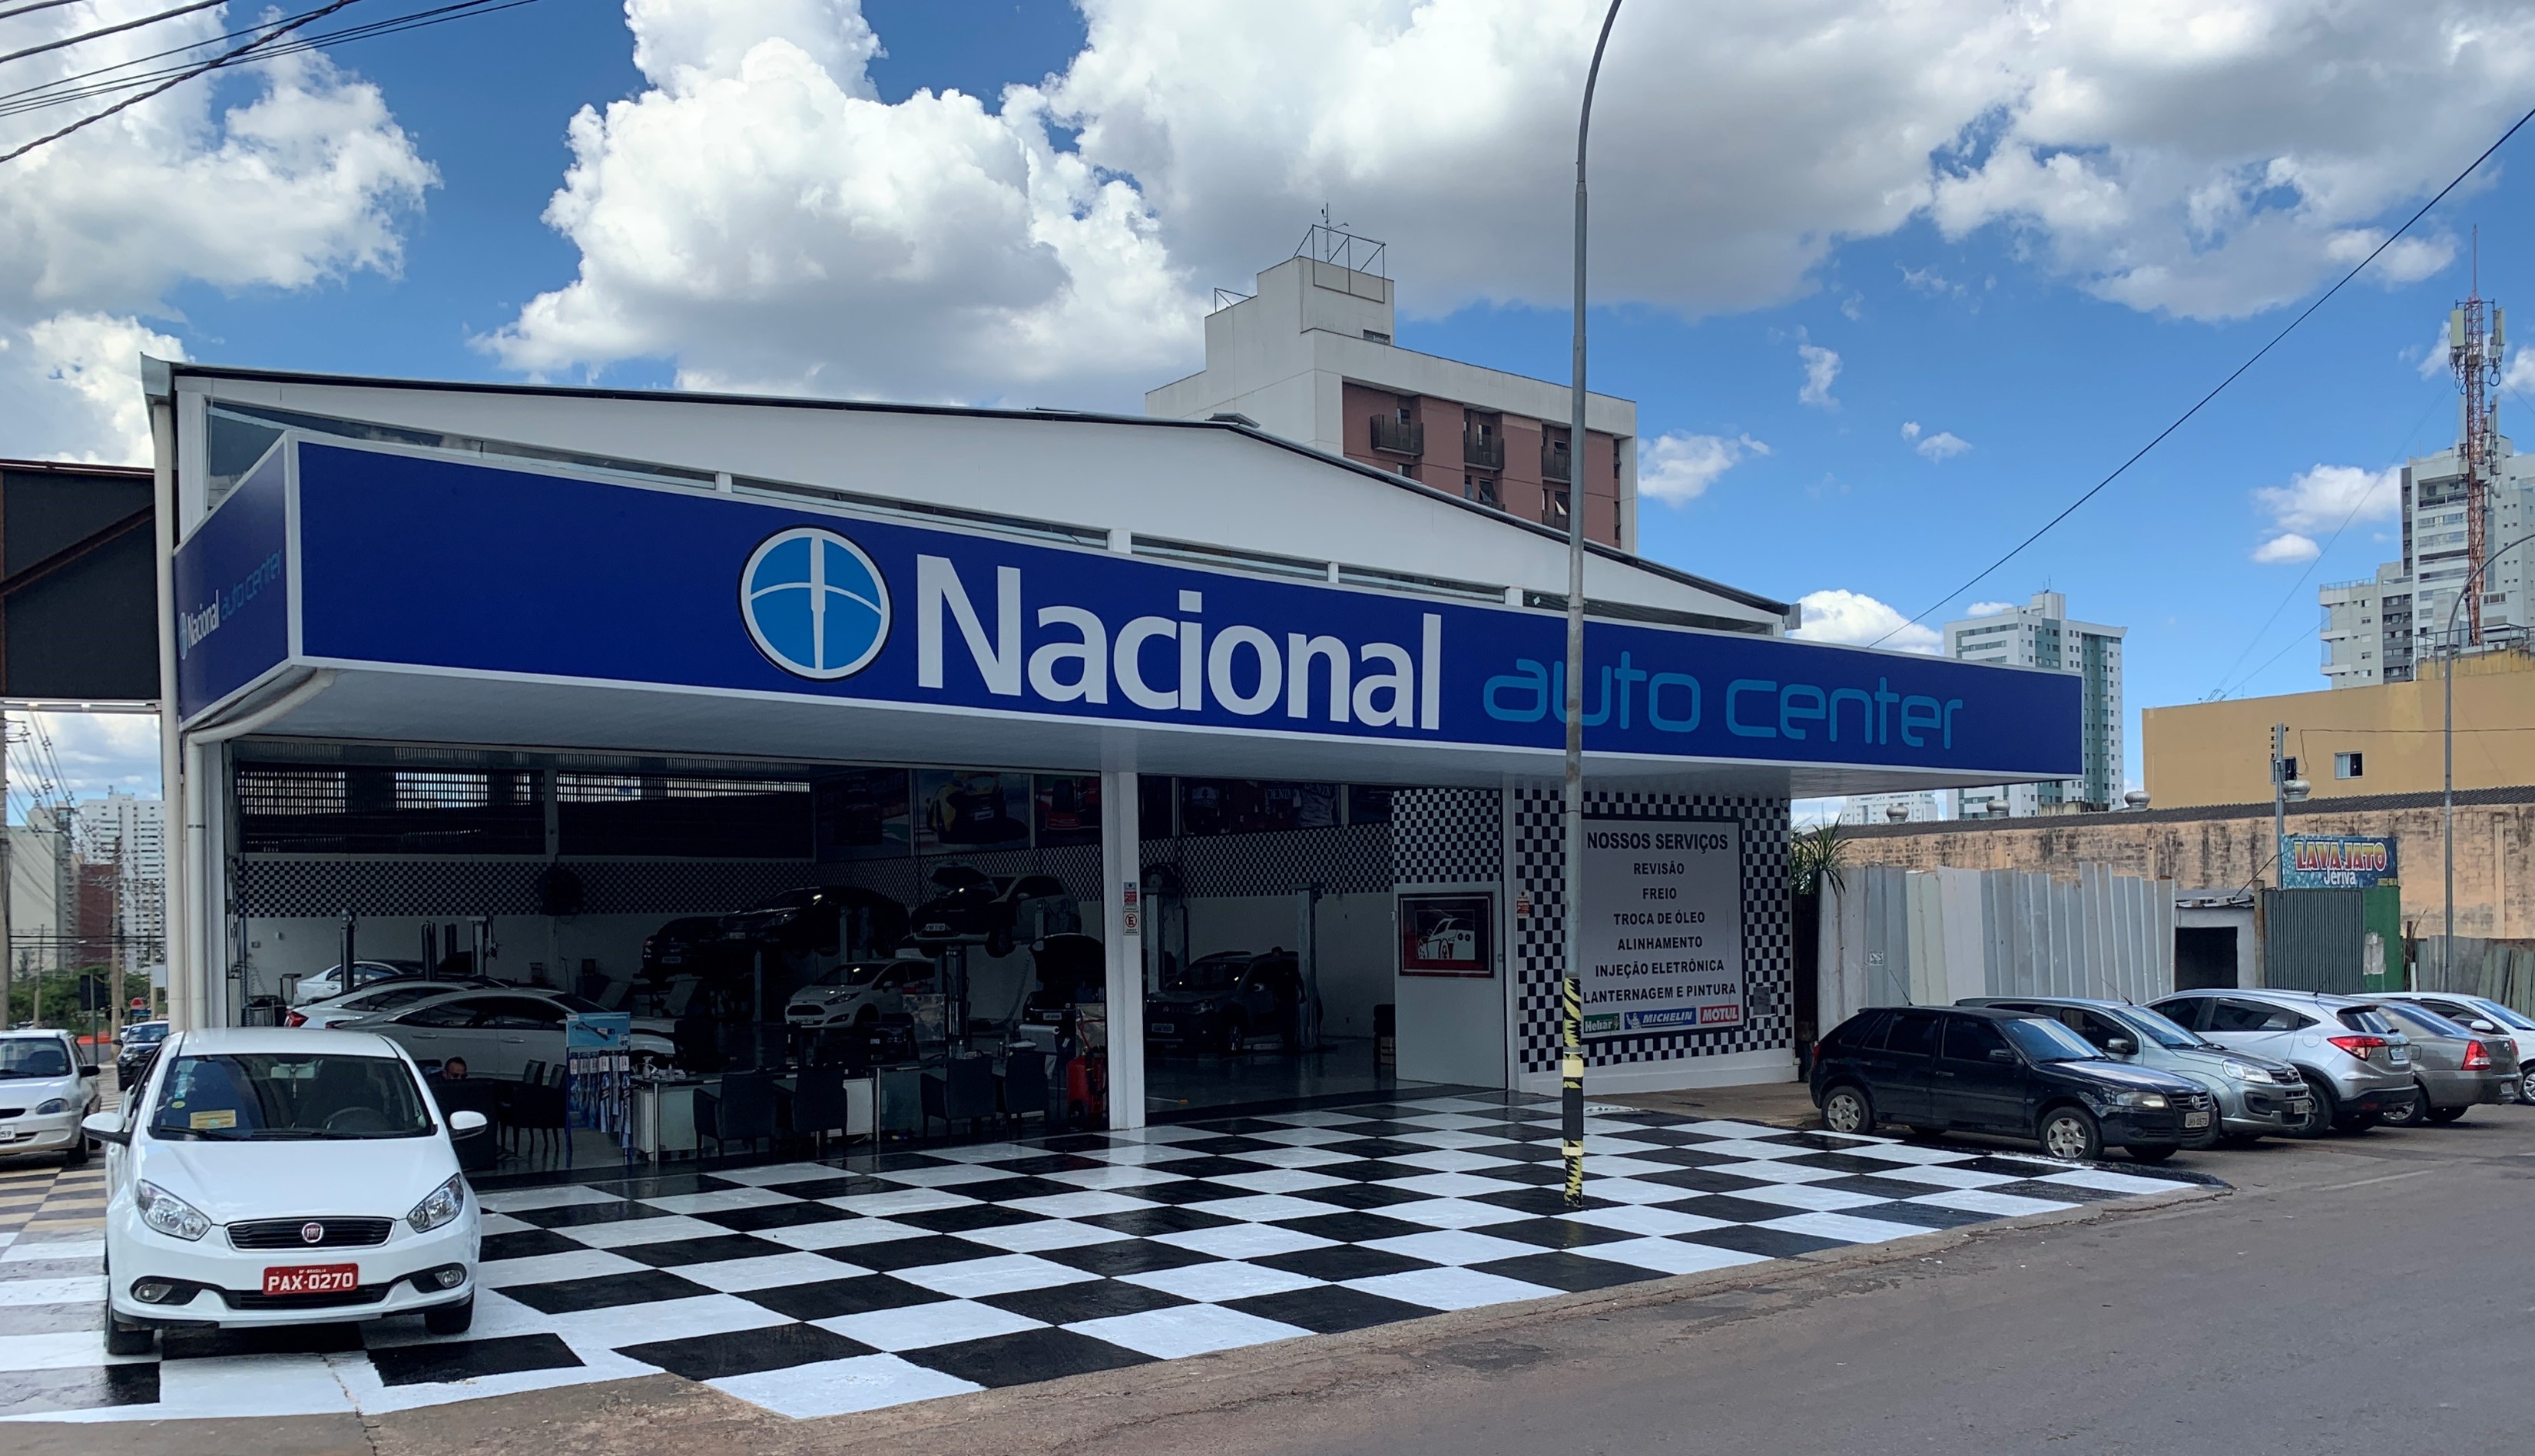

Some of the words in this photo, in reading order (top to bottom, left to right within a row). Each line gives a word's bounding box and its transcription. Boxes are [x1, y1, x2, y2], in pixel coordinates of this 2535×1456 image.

[187, 588, 220, 650] Nacional
[220, 583, 244, 621] auto
[245, 549, 283, 601] center
[918, 554, 1441, 730] Nacional
[1483, 650, 1701, 733] auto
[1725, 677, 1963, 750] center
[1587, 832, 1651, 849] NOSSOS
[1655, 833, 1728, 854] SERVIÇOS
[2293, 841, 2341, 871] LAVA
[2343, 841, 2388, 872] JATO
[1633, 860, 1685, 875] REVISÃO
[1642, 888, 1677, 899] FREIO
[1613, 913, 1654, 925] TROCA
[1657, 912, 1672, 925] DE
[1675, 909, 1705, 923] ÓLEO
[1617, 935, 1703, 951] ALINHAMENTO
[1596, 961, 1649, 979] INJEÇÃO
[1652, 958, 1725, 975] ELETRÔNICA
[1583, 986, 1673, 1004] LANTERNAGEM
[1677, 986, 1683, 998] E
[1686, 983, 1736, 997] PINTURA
[1642, 1011, 1694, 1023] MICHELIN
[1702, 1007, 1738, 1021] MOTUL
[1585, 1020, 1612, 1032] Heliar
[307, 1228, 320, 1237] FIAT
